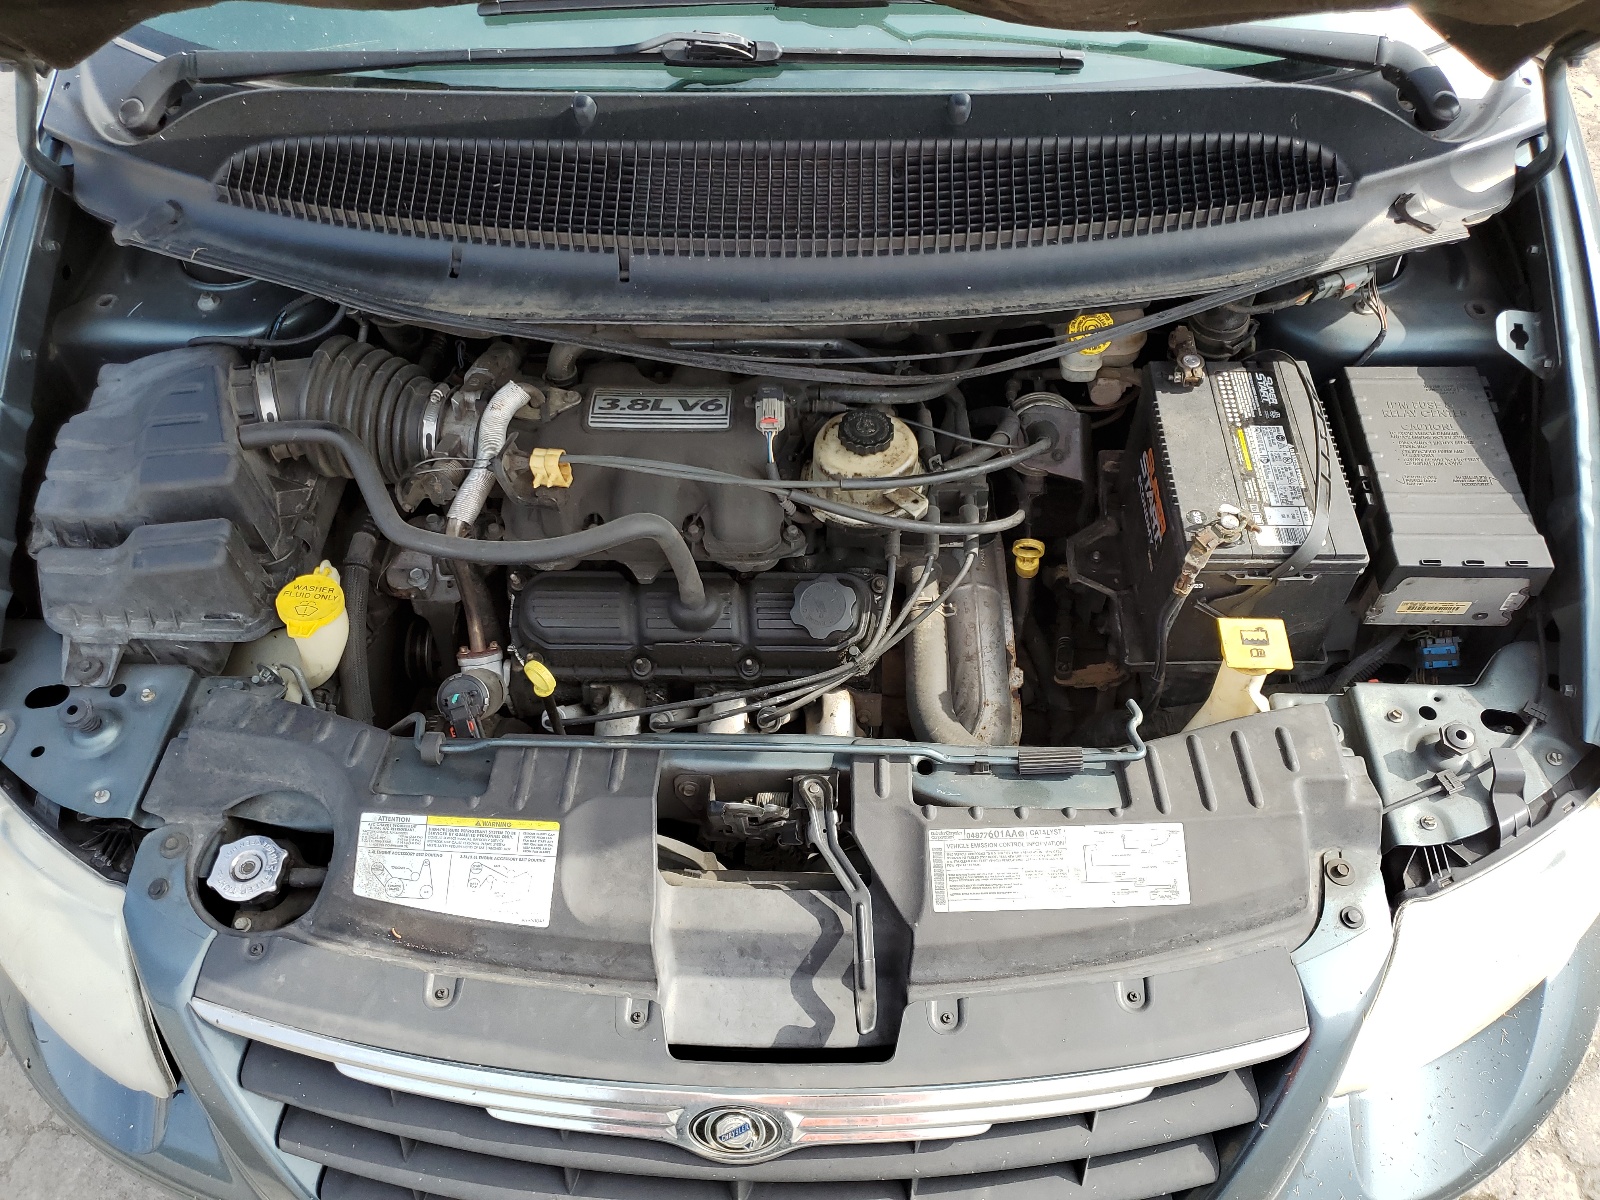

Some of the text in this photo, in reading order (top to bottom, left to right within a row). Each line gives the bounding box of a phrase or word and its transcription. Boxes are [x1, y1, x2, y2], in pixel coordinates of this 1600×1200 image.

[597, 398, 724, 412] 3.8L V6
[293, 584, 335, 593] WASHER
[283, 590, 311, 599] FLUID
[378, 815, 411, 823] ATTENTION
[1029, 828, 1062, 836] CATALYST
[970, 841, 998, 849] EMISSION
[721, 1123, 750, 1142] CHRYSLER
